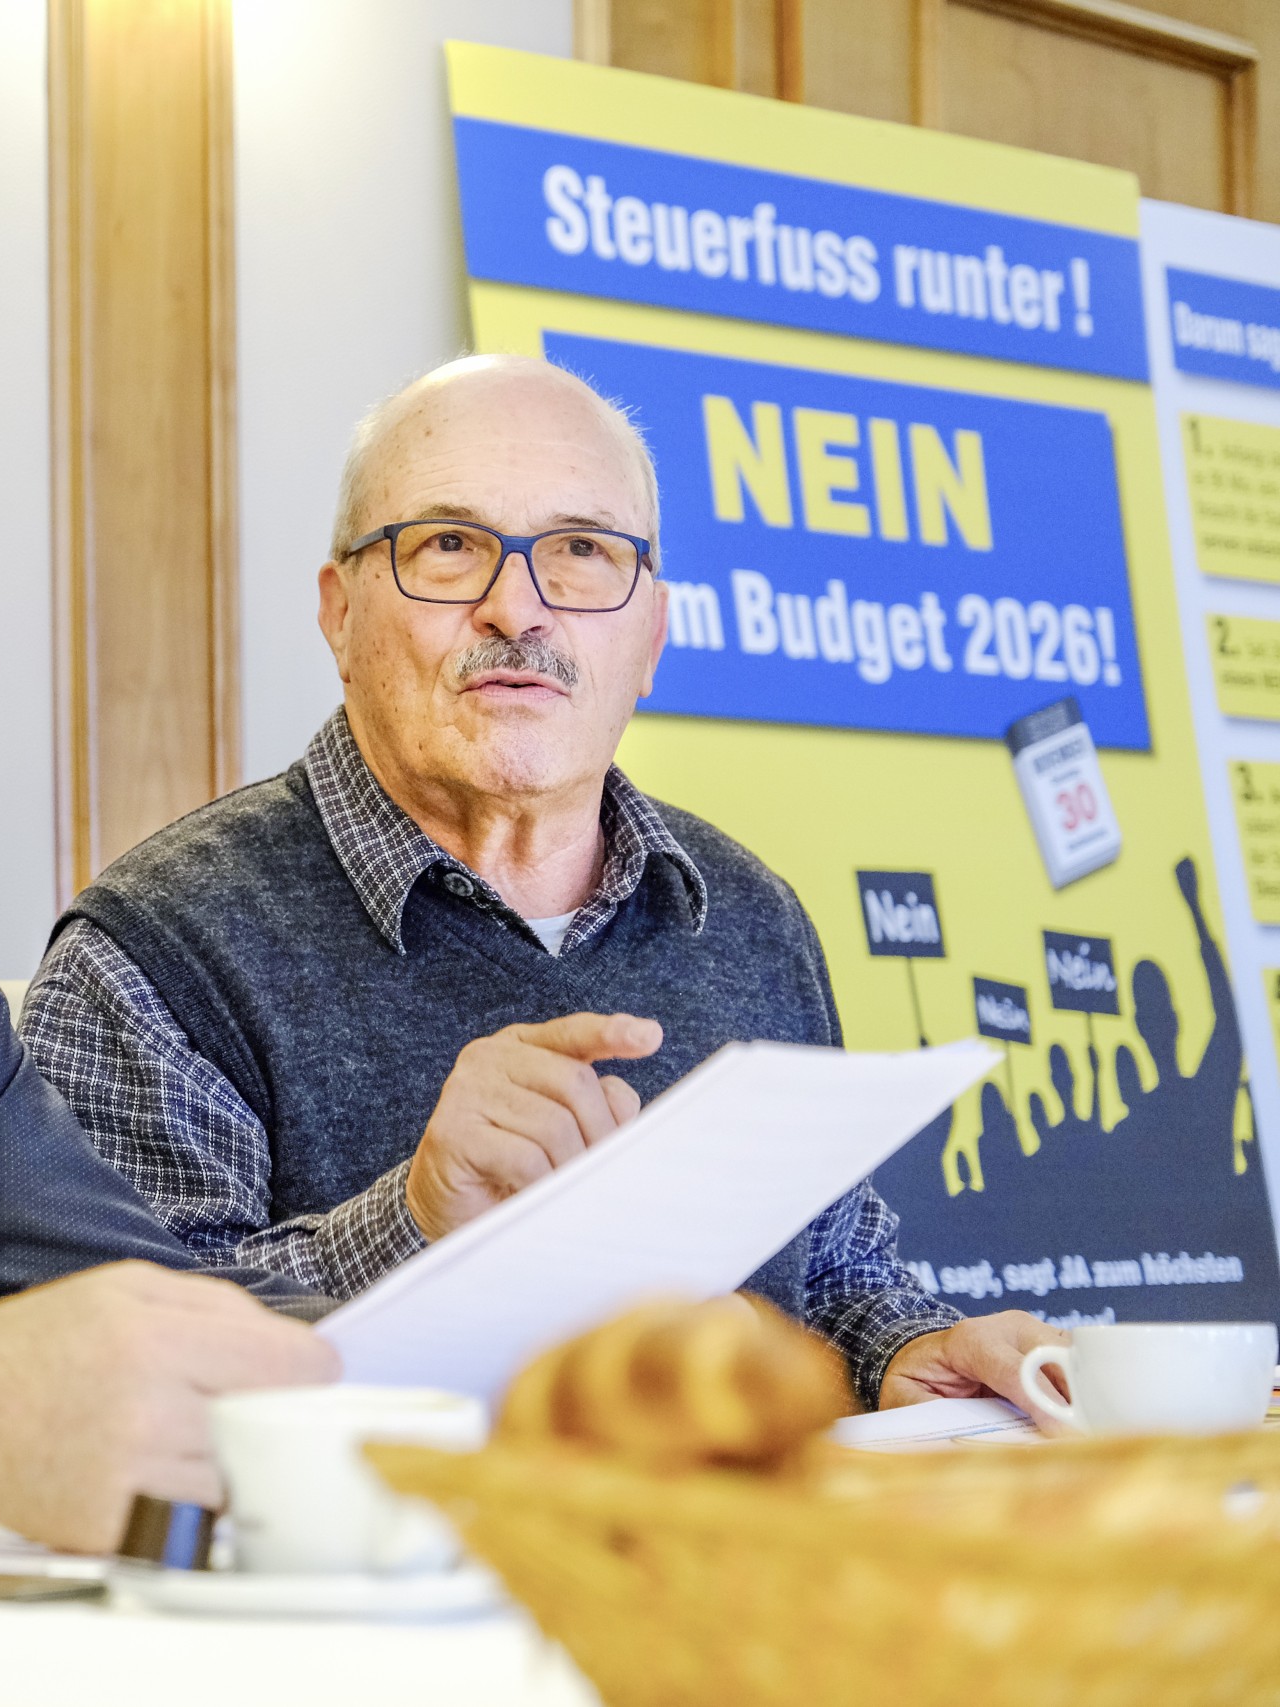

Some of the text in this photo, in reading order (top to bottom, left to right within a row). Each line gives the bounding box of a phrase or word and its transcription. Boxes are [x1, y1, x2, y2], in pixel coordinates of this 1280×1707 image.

[542, 164, 1094, 337] Steuerfuss runter!
[1173, 300, 1246, 357] Darum
[702, 394, 994, 552] NEIN
[668, 568, 1122, 687] m Budget 2026!
[1215, 615, 1241, 656] 2.
[1056, 783, 1098, 832] 30
[864, 889, 941, 944] Nein
[1044, 941, 1118, 992] Nein
[976, 994, 1031, 1033] Nein
[939, 1259, 1003, 1299] sagt,
[1003, 1257, 1058, 1297] sagt
[1059, 1254, 1093, 1289] JA
[1092, 1259, 1142, 1288] zum
[1141, 1251, 1244, 1286] höchsten
